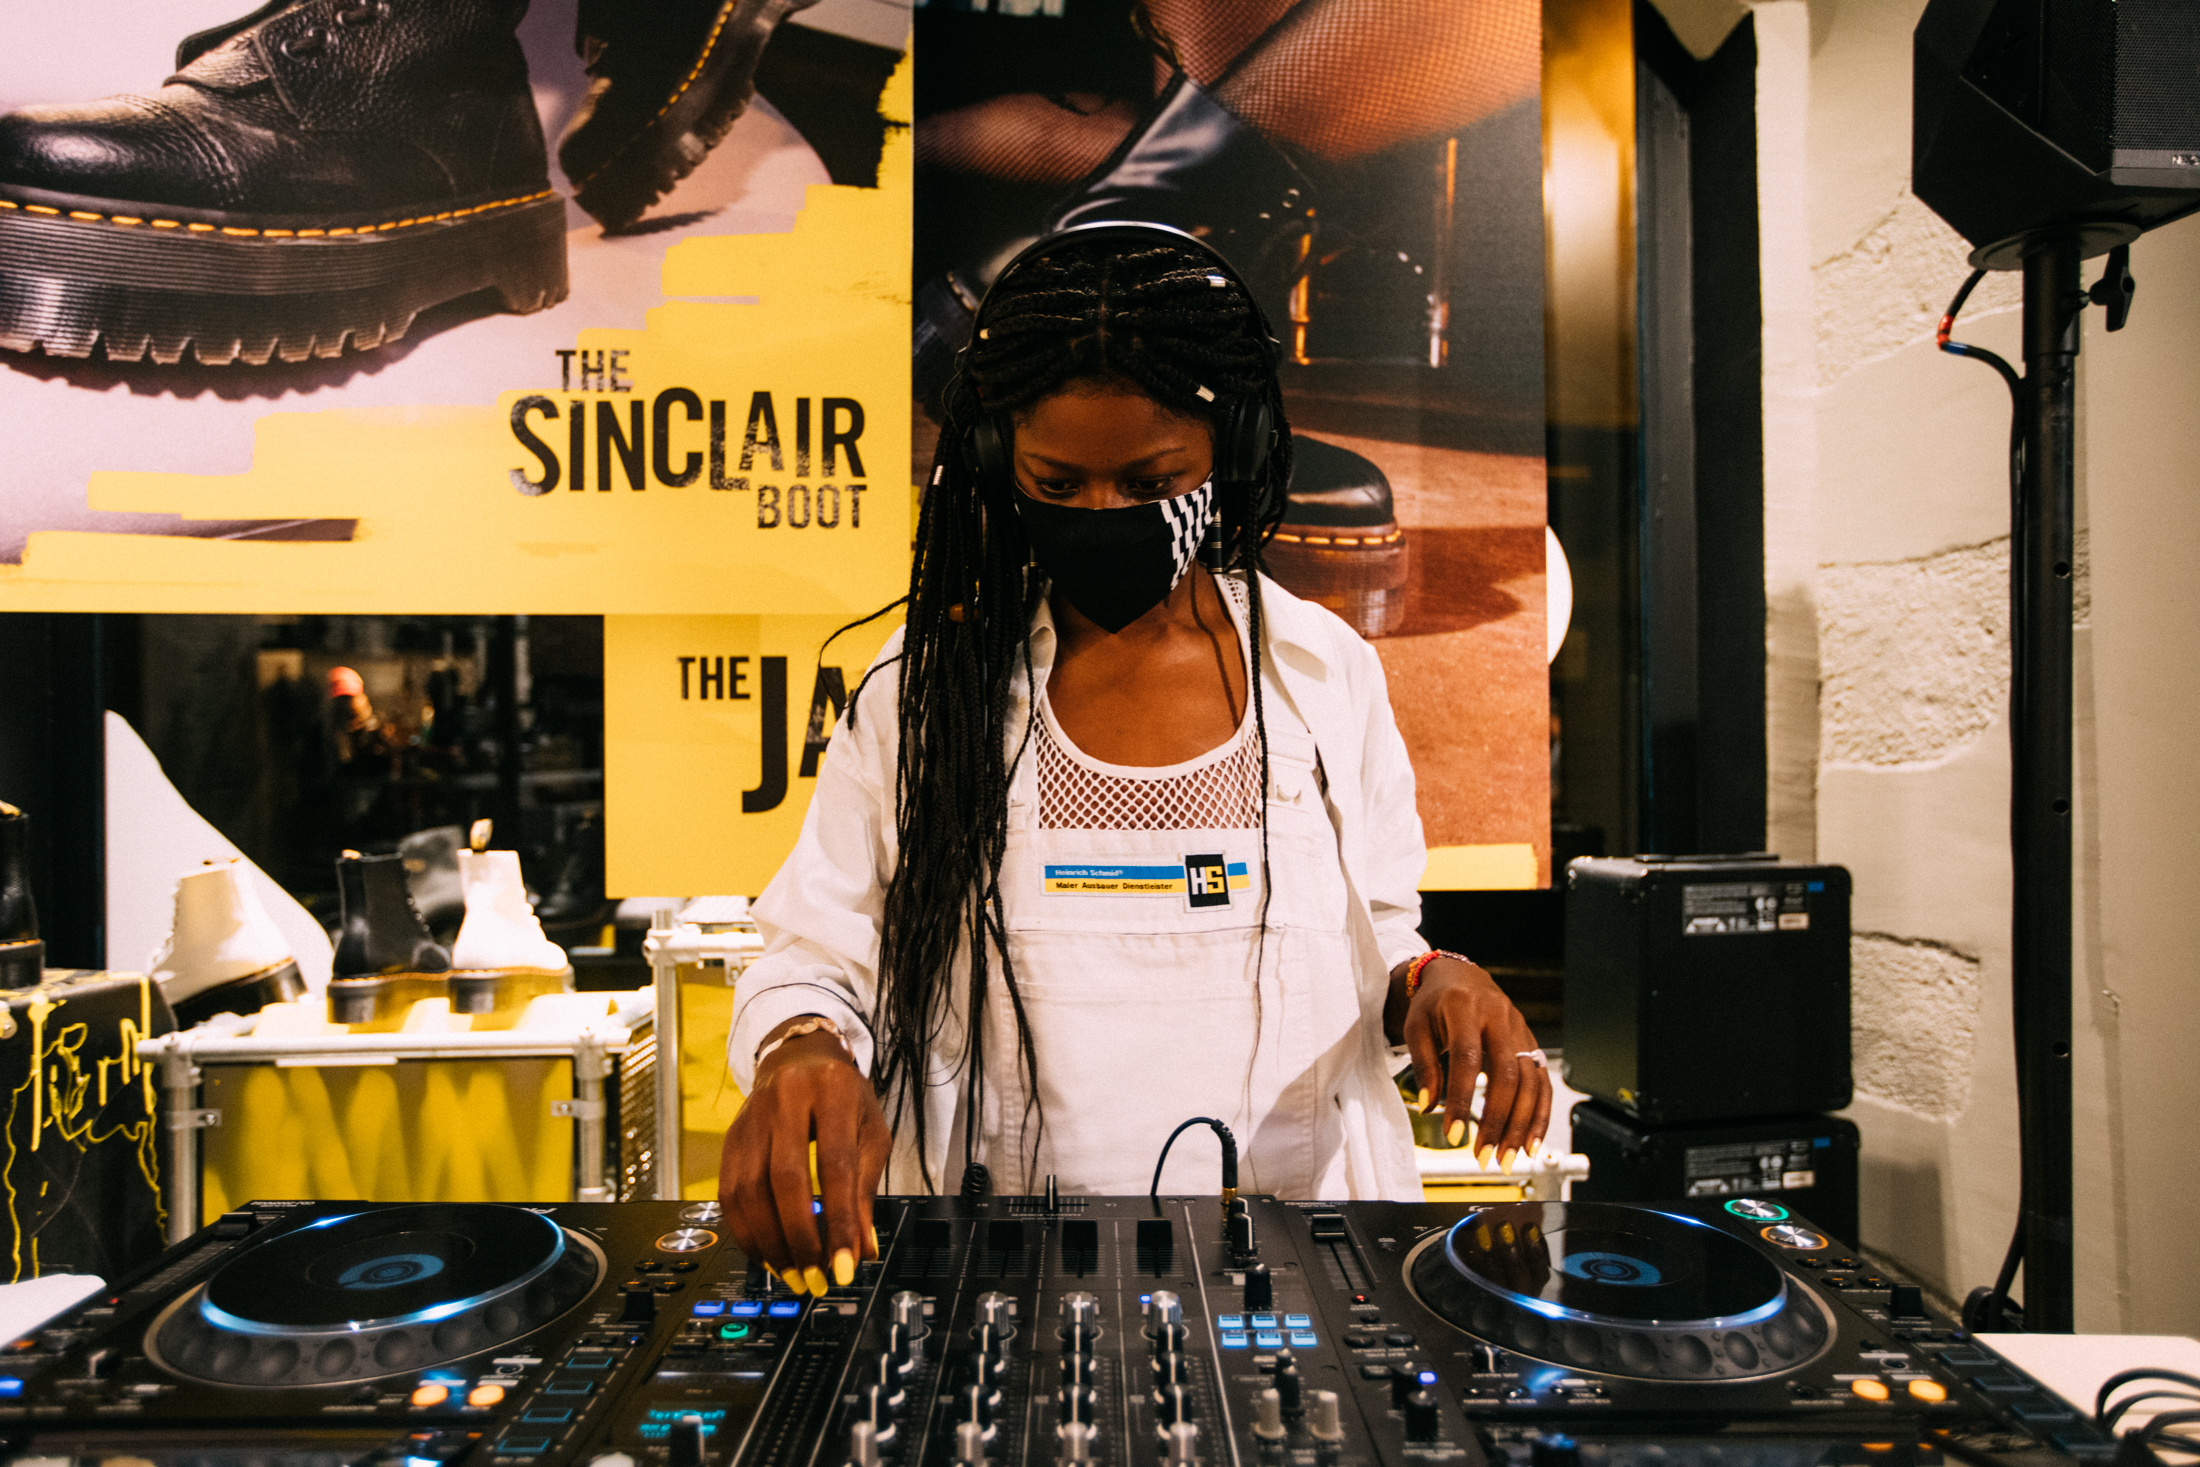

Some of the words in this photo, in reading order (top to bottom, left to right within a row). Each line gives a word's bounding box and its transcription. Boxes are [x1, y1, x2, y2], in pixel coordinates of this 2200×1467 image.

[555, 349, 632, 393] THE
[508, 386, 867, 497] SINCLAIR
[757, 484, 868, 529] BOOT
[677, 656, 751, 700] THE
[742, 656, 858, 814] JA
[1082, 882, 1119, 890] Ausbauer
[1122, 882, 1173, 890] Dienstleister
[1190, 866, 1225, 895] HS
